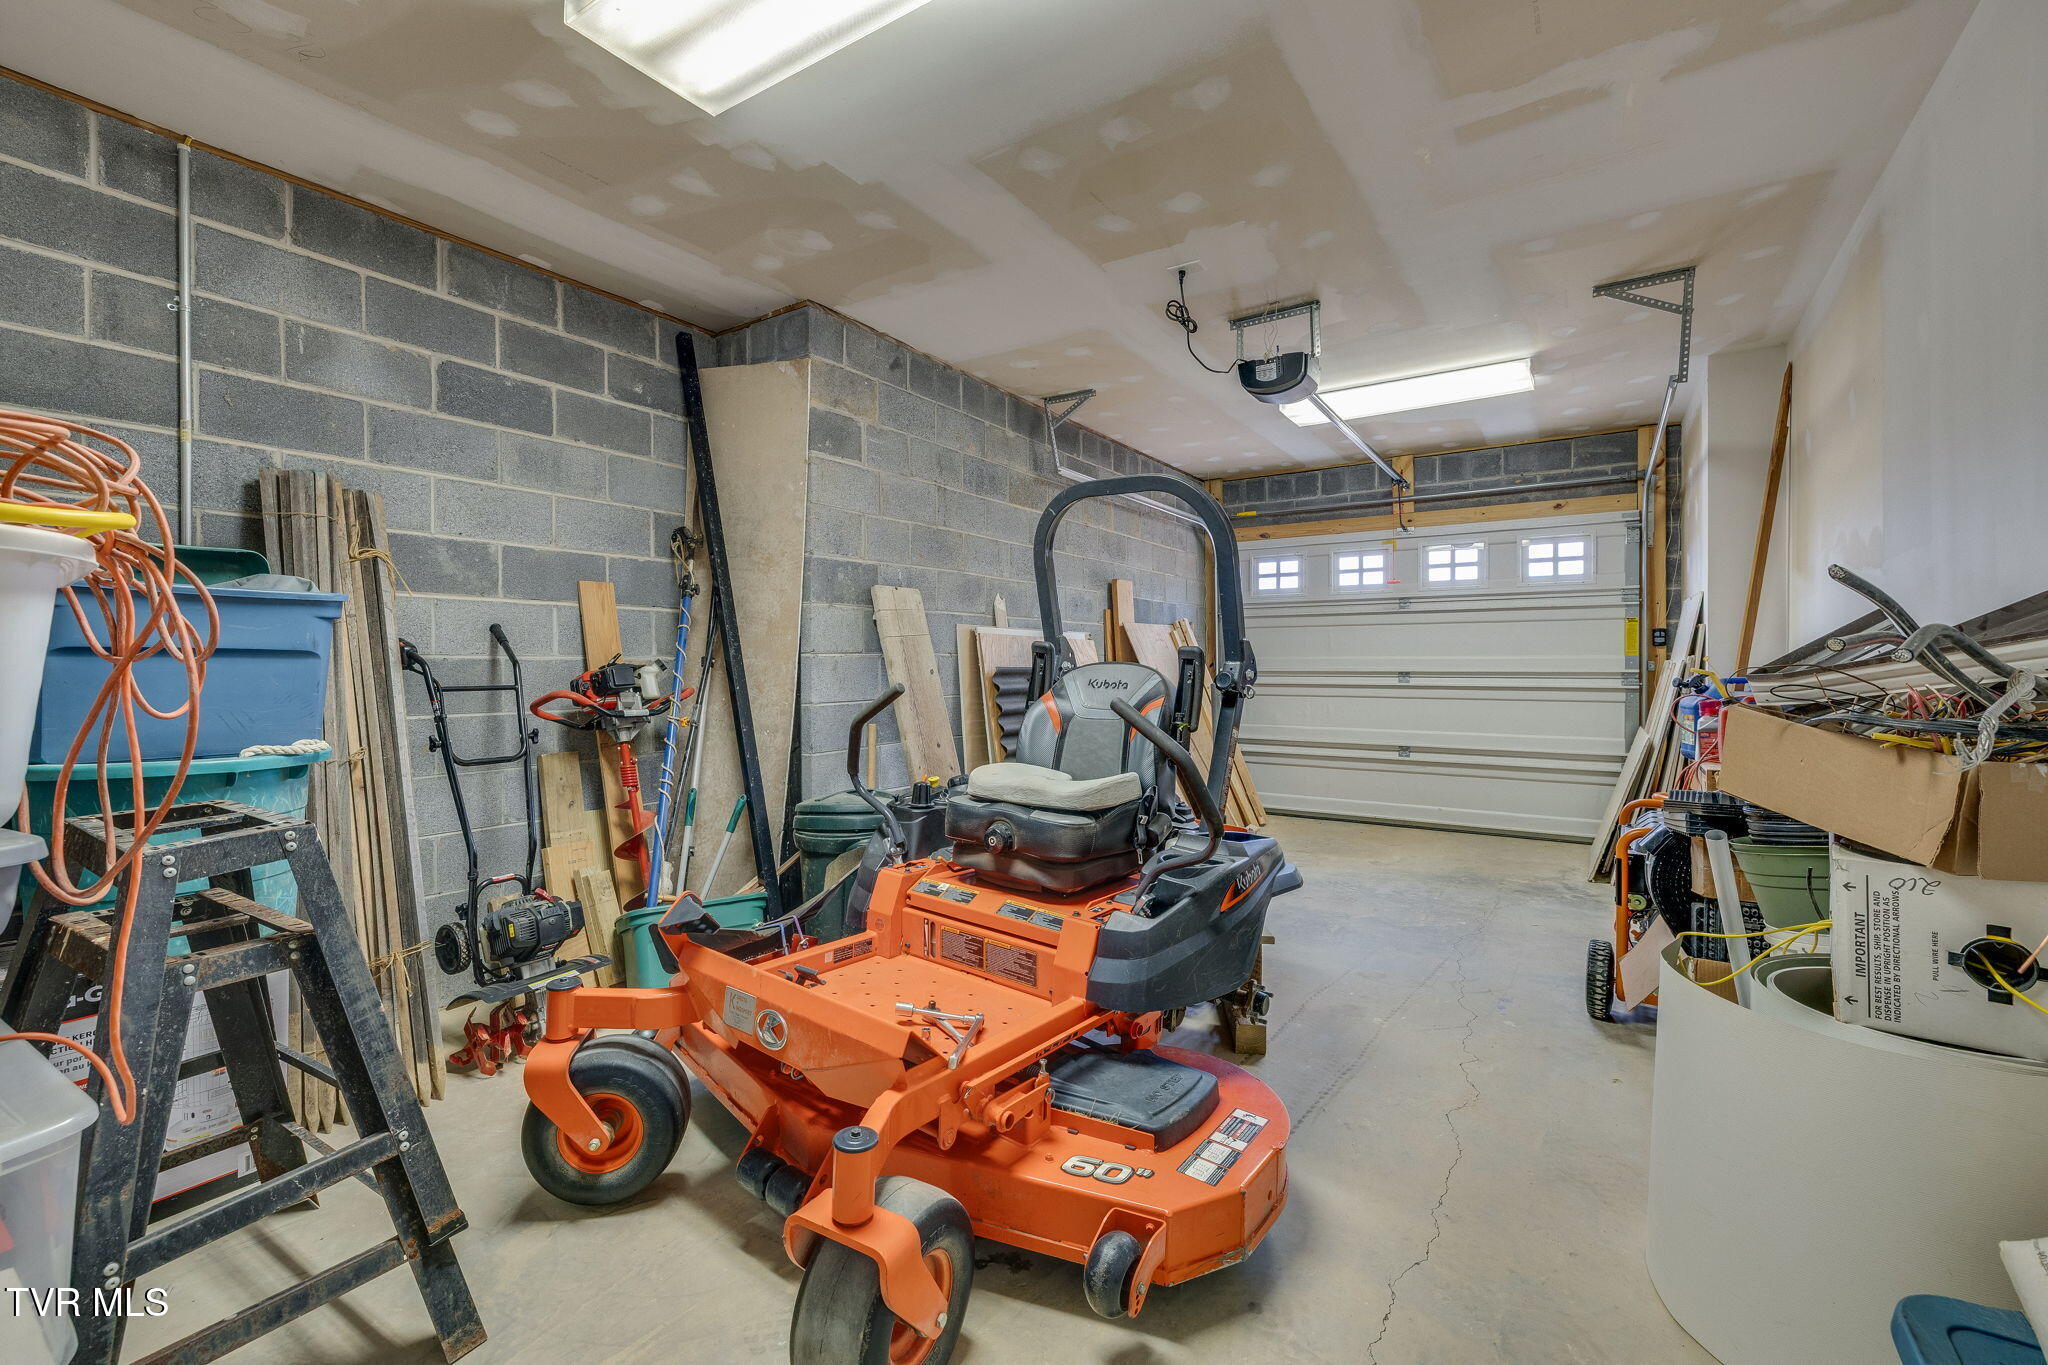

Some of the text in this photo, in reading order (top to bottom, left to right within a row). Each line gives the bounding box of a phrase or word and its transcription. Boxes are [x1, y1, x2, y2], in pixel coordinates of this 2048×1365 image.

[1087, 678, 1129, 690] Kubota
[1854, 911, 1867, 978] IMPORTANT
[1872, 890, 1883, 1020] FOR BEST RESULTS, SHIP, STORE AND
[1882, 897, 1892, 1022] DISPENSE IN UPRIGHT POSITION AS
[1892, 923, 1901, 972] DIRECTIONAL
[1931, 931, 1940, 982] PULL WIRE HERE
[1892, 973, 1901, 983] BY
[1893, 985, 1902, 1024] INDICATED
